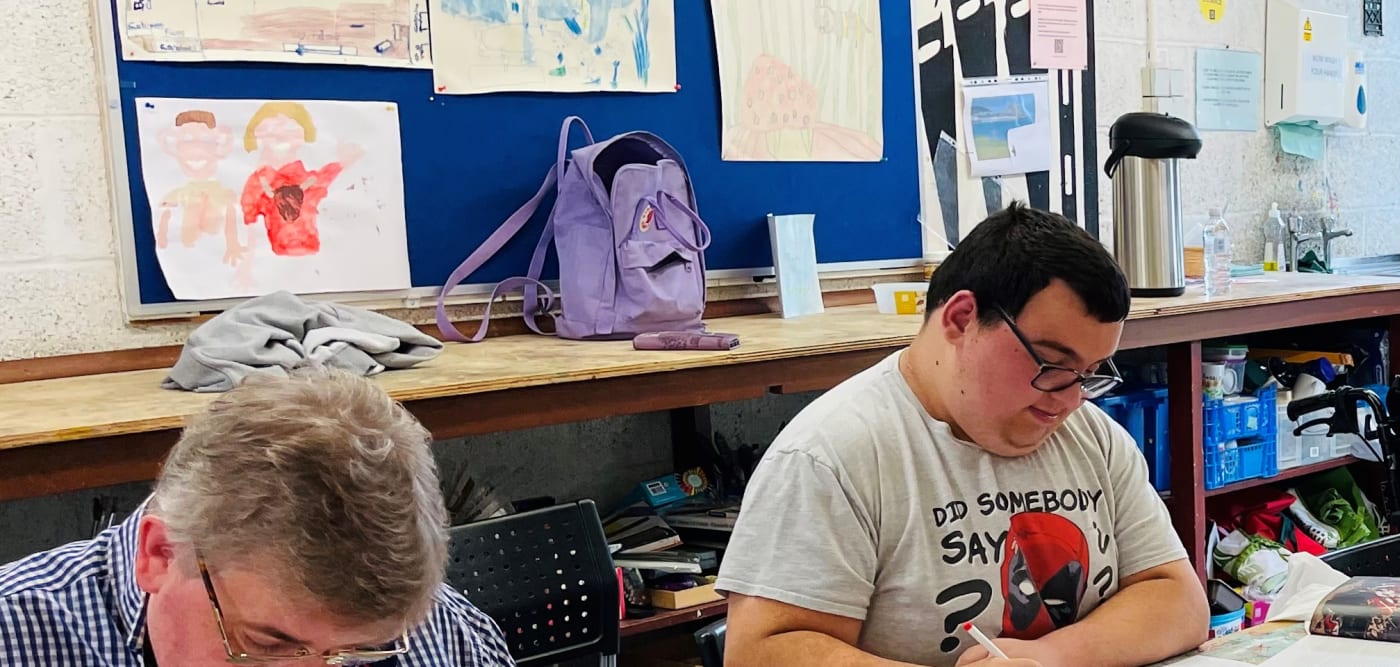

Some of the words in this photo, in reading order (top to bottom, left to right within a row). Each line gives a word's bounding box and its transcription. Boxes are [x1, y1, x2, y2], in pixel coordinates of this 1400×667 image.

[933, 501, 968, 527] DID
[977, 488, 1102, 516] SOMEBODY
[941, 530, 1009, 564] SAY
